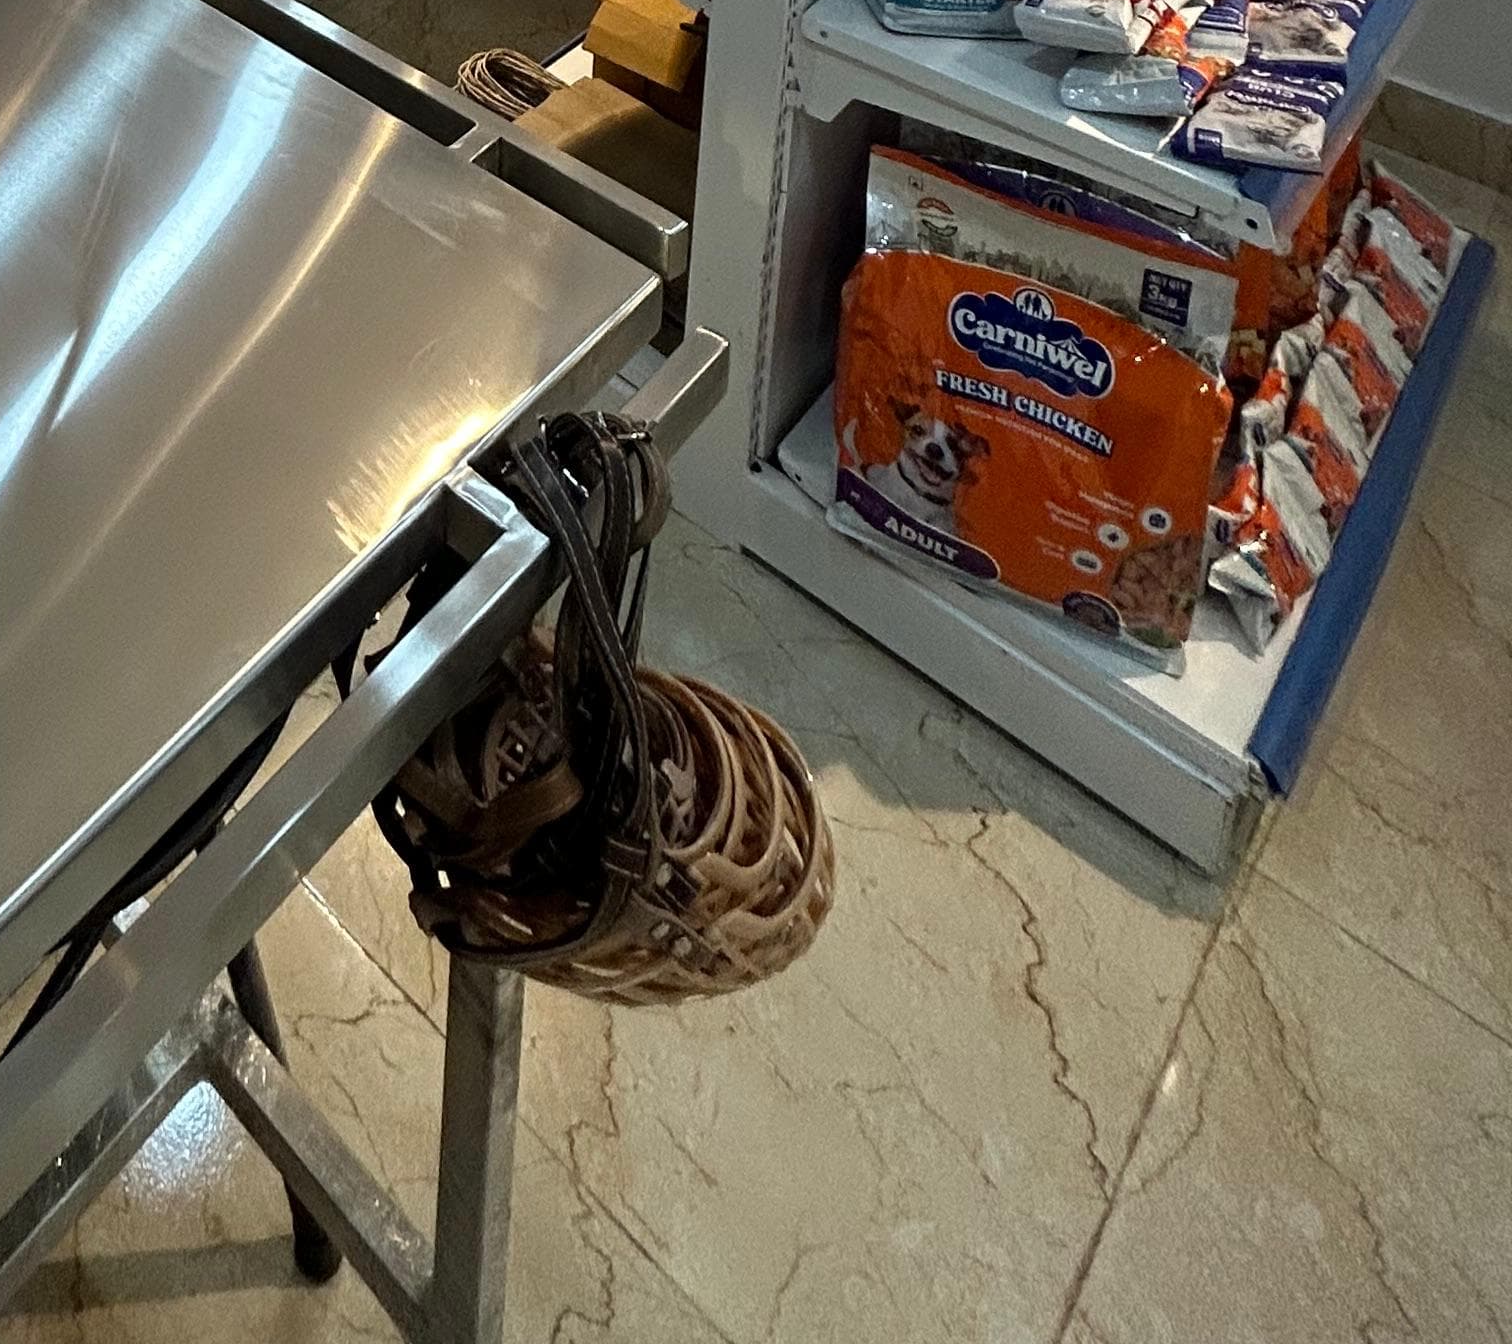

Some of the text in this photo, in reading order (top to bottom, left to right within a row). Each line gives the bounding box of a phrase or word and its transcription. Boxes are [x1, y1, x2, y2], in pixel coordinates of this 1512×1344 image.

[954, 308, 1109, 389] Carniwel
[935, 370, 1009, 407] FRESH
[1014, 395, 1115, 455] CHICKEN
[884, 516, 960, 562] ADULT
